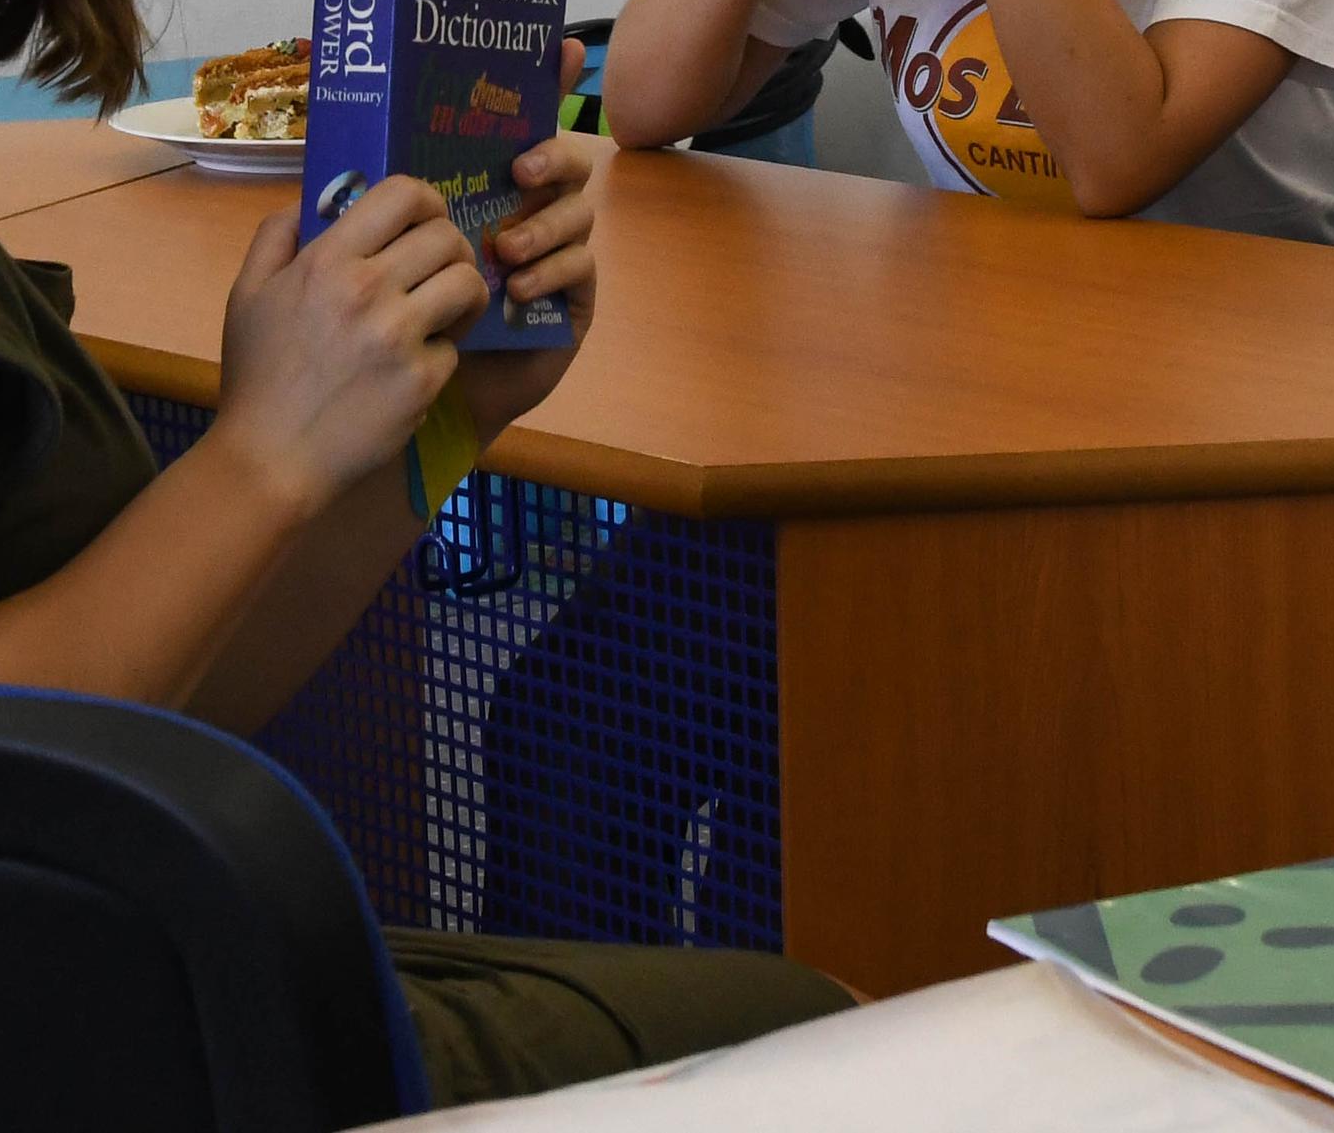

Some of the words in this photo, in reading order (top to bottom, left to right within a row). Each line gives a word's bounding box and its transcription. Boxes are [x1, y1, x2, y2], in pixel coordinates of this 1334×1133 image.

[316, 86, 383, 107] Dictionary
[467, 170, 490, 193] out
[526, 311, 562, 325] CD-ROM
